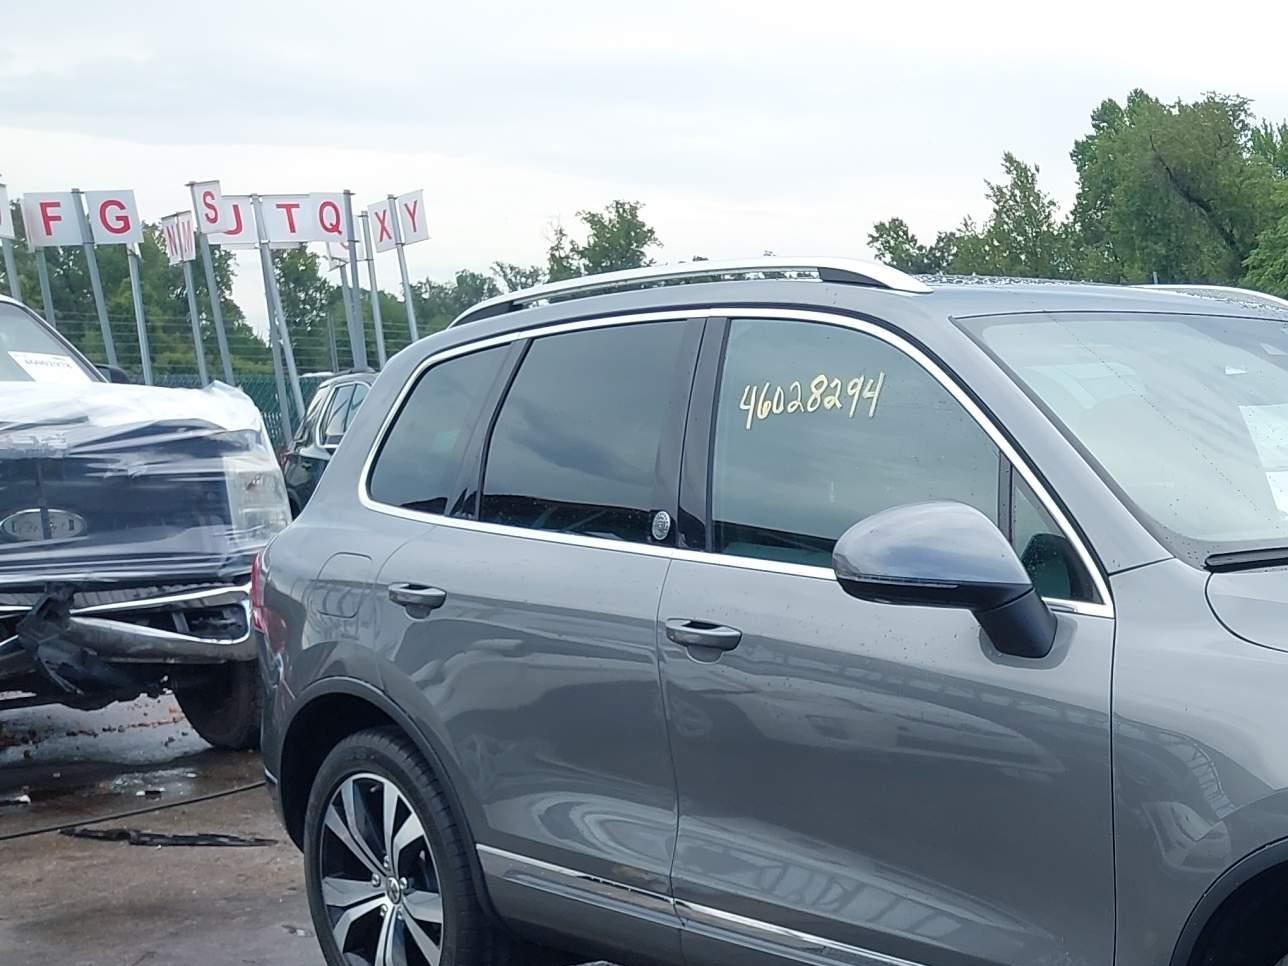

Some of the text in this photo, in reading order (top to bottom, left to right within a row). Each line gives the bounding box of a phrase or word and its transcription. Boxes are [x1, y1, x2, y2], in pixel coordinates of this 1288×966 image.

[39, 201, 62, 236] F
[99, 199, 131, 234] G
[202, 191, 219, 224] S
[223, 204, 243, 236] J
[275, 203, 300, 233] T
[318, 201, 343, 235] Q
[404, 199, 418, 234] Y
[166, 225, 178, 257] N
[376, 209, 392, 242] X
[739, 372, 886, 430] 46028294
